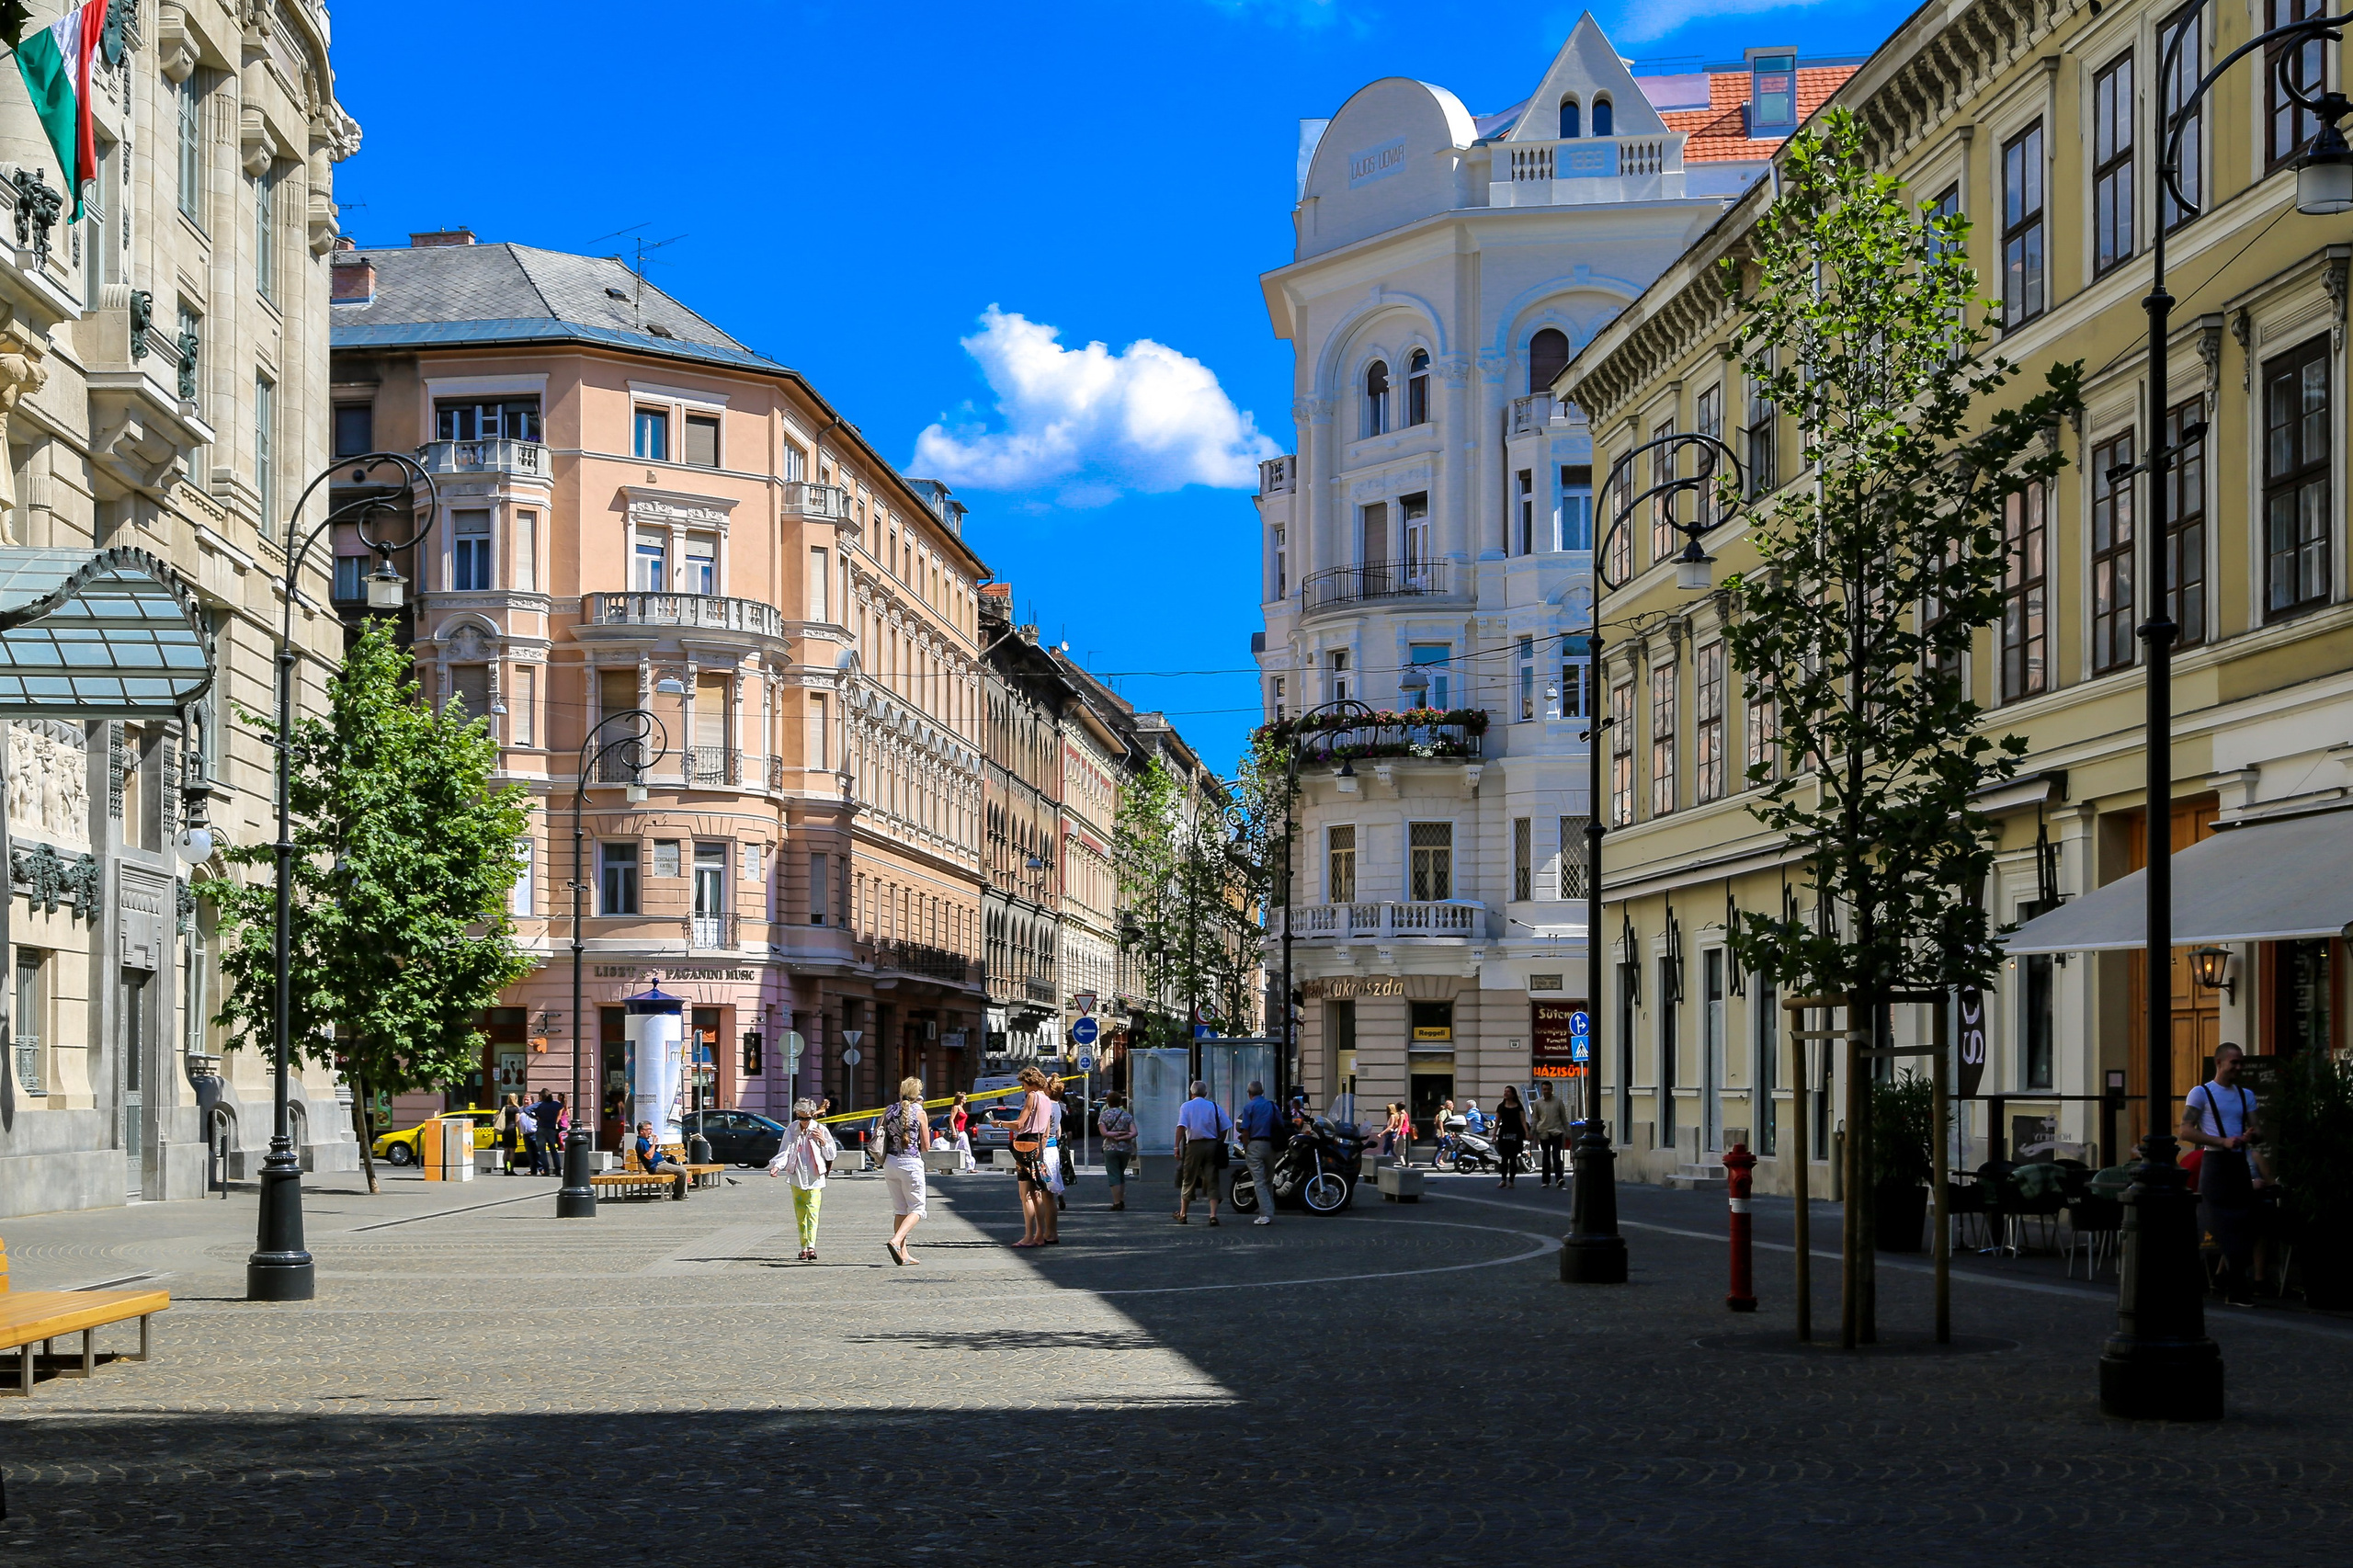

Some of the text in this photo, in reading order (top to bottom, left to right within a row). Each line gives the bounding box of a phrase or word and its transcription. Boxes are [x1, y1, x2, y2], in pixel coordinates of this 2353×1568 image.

[1351, 155, 1376, 180] LAJOS
[594, 966, 637, 977] LISZT
[665, 968, 723, 981] PAGANINI
[725, 969, 755, 981] MUSIC
[1329, 977, 1404, 997] Cukrászda
